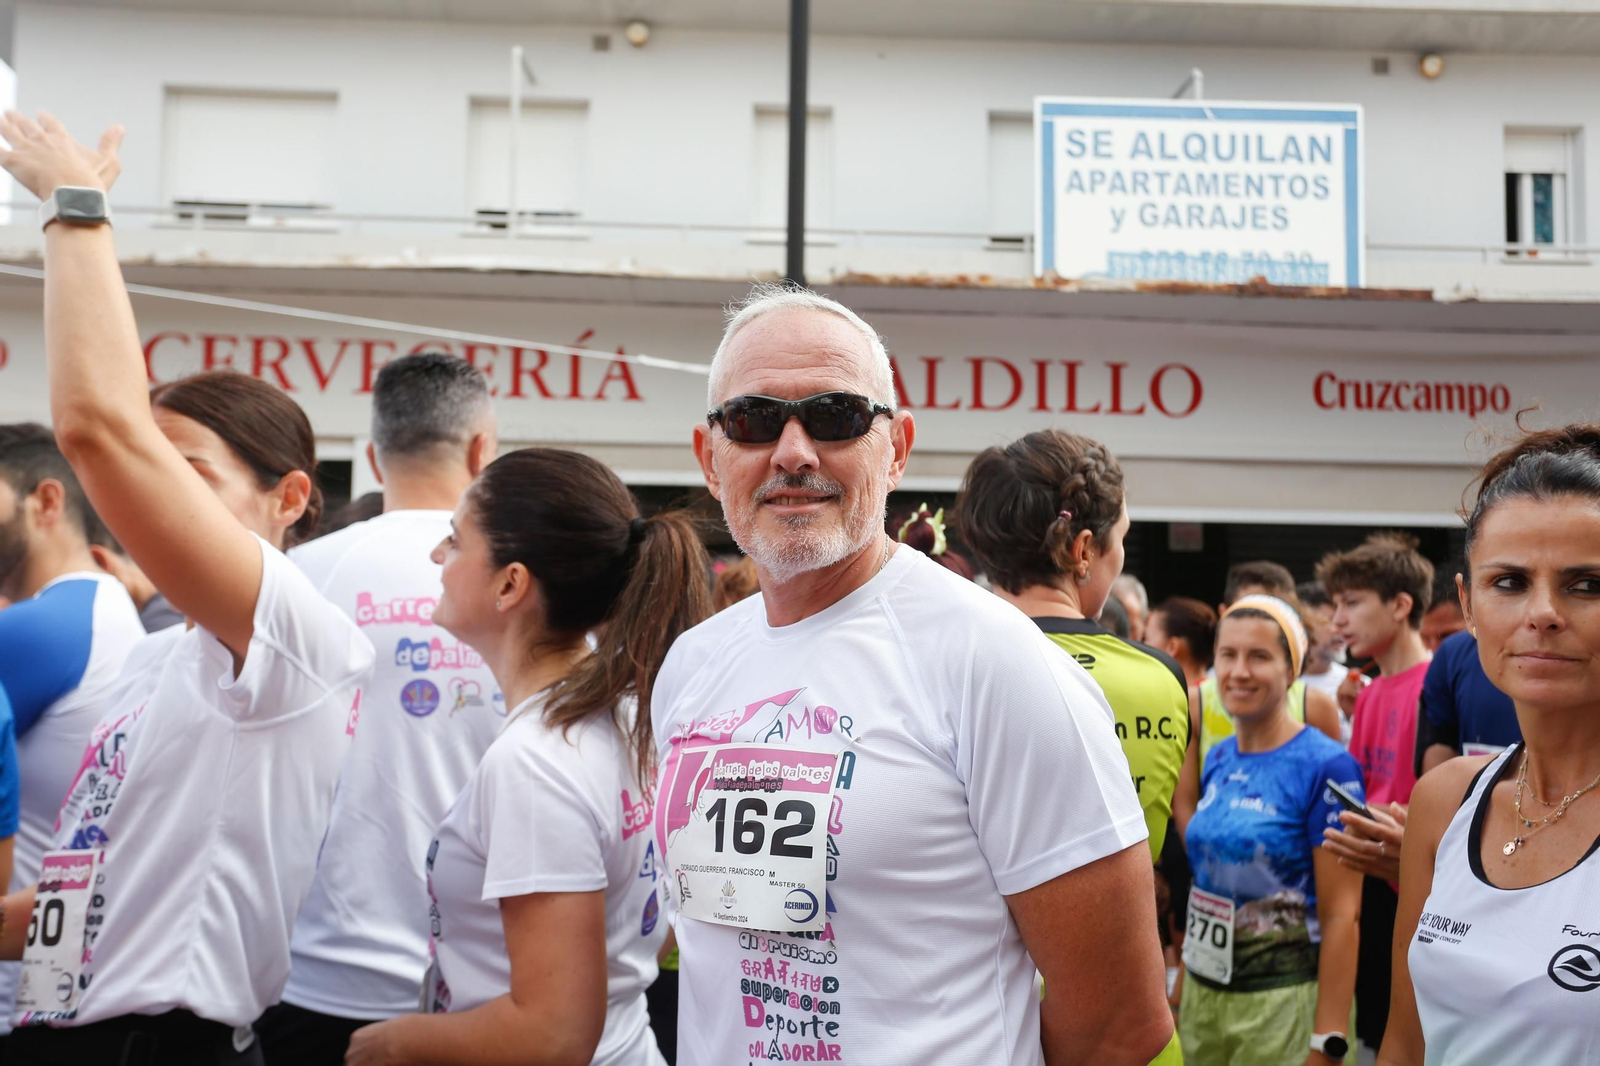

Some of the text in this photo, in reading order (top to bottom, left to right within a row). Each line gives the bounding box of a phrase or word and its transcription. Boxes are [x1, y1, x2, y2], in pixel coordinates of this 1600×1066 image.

[1065, 128, 1334, 165] SE ALQUILAN
[1065, 169, 1331, 201] APARTAMENTOS
[1110, 202, 1290, 233] y GARAJES
[1312, 371, 1512, 418] Cruzcampo
[1136, 716, 1177, 740] R.C.
[705, 797, 816, 859] 162
[680, 863, 776, 878] DORADO GUERRERO, FRANCISCO M
[769, 880, 796, 889] MASTER
[718, 912, 738, 922] Septiembre
[738, 915, 749, 923] 2024
[784, 900, 813, 911] ACERINOX
[1189, 913, 1227, 949] 270
[1429, 914, 1452, 933] YOUR
[1450, 920, 1472, 937] WAY
[1439, 935, 1462, 945] CONCEPT
[742, 995, 840, 1043] Deporte
